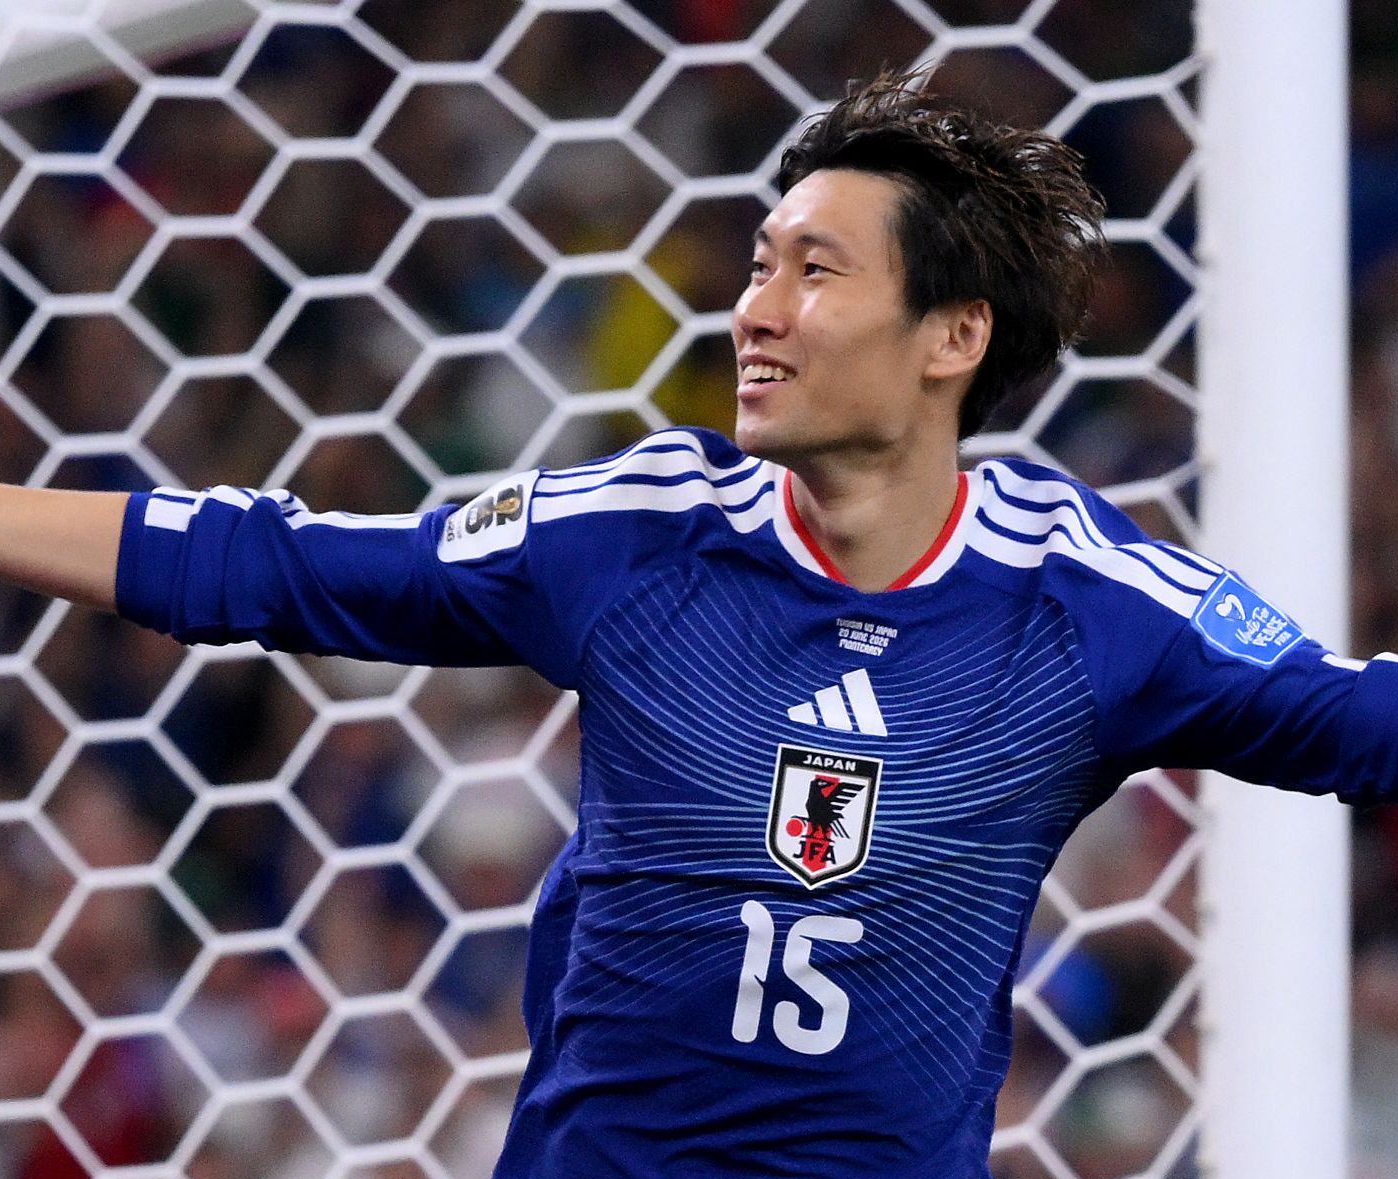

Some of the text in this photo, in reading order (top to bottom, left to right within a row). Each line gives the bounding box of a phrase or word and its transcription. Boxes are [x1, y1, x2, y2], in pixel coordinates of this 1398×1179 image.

[869, 634, 890, 648] 2026
[1251, 616, 1288, 647] PEACE
[803, 754, 857, 772] JAPAN
[793, 840, 837, 865] JFA
[732, 900, 864, 1055] 15
